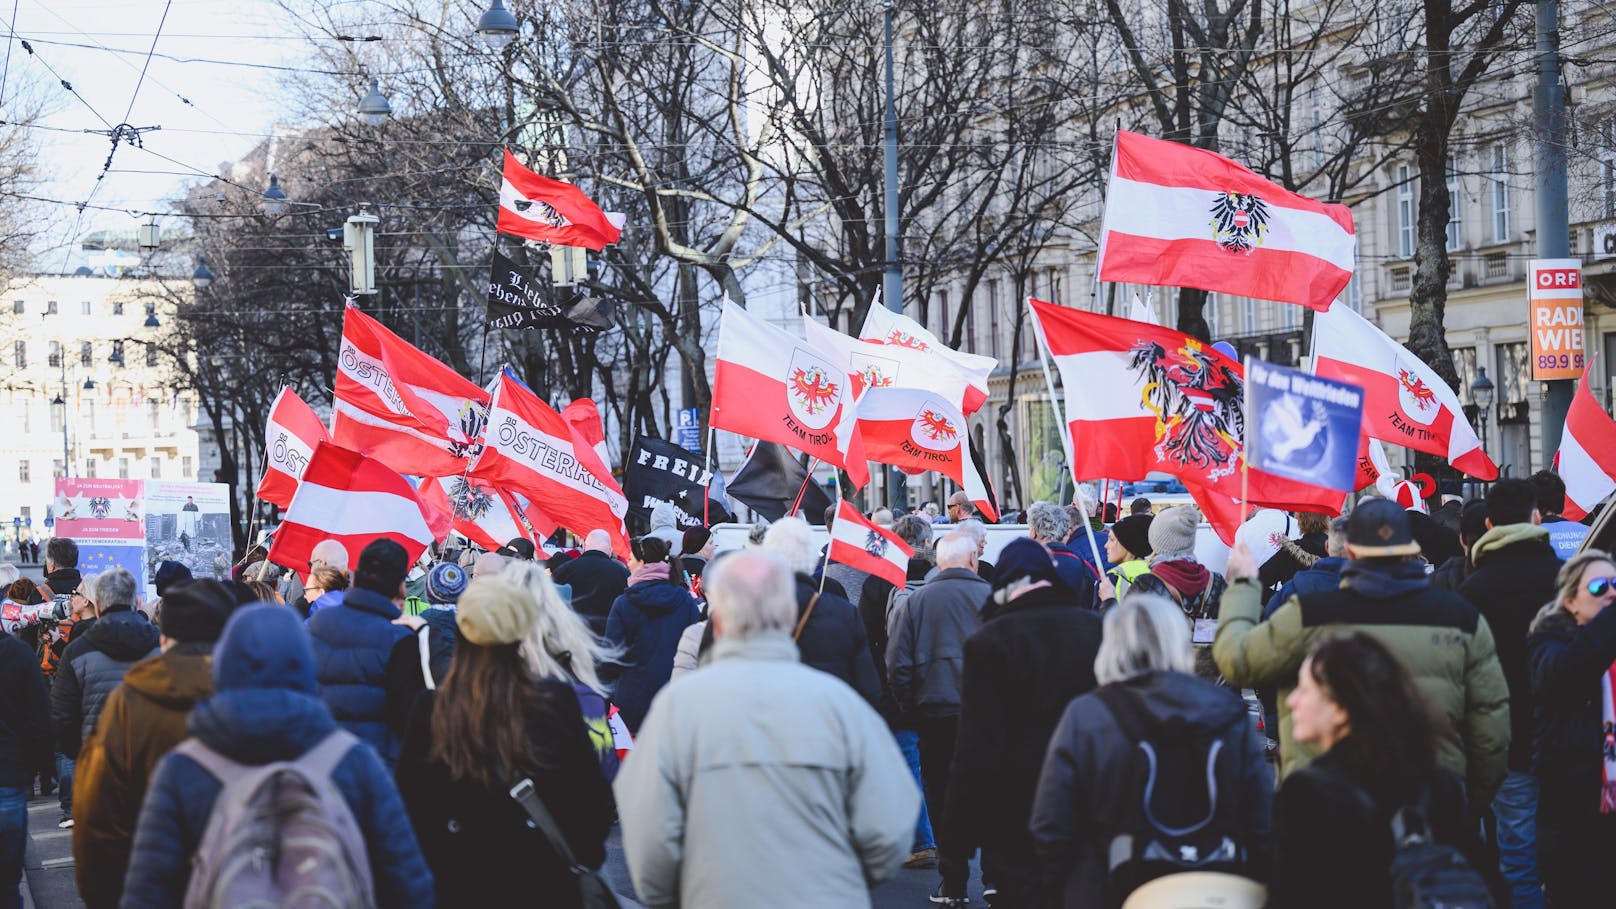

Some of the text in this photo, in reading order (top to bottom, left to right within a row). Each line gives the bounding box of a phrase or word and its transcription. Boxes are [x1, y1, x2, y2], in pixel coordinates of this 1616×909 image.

[1539, 272, 1577, 286] ORF
[1536, 307, 1584, 327] RADI
[1538, 354, 1569, 369] 89.9
[782, 414, 833, 446] TEAM TIROL
[1388, 411, 1415, 437] TEAM
[900, 439, 952, 462] TEAM TIROL
